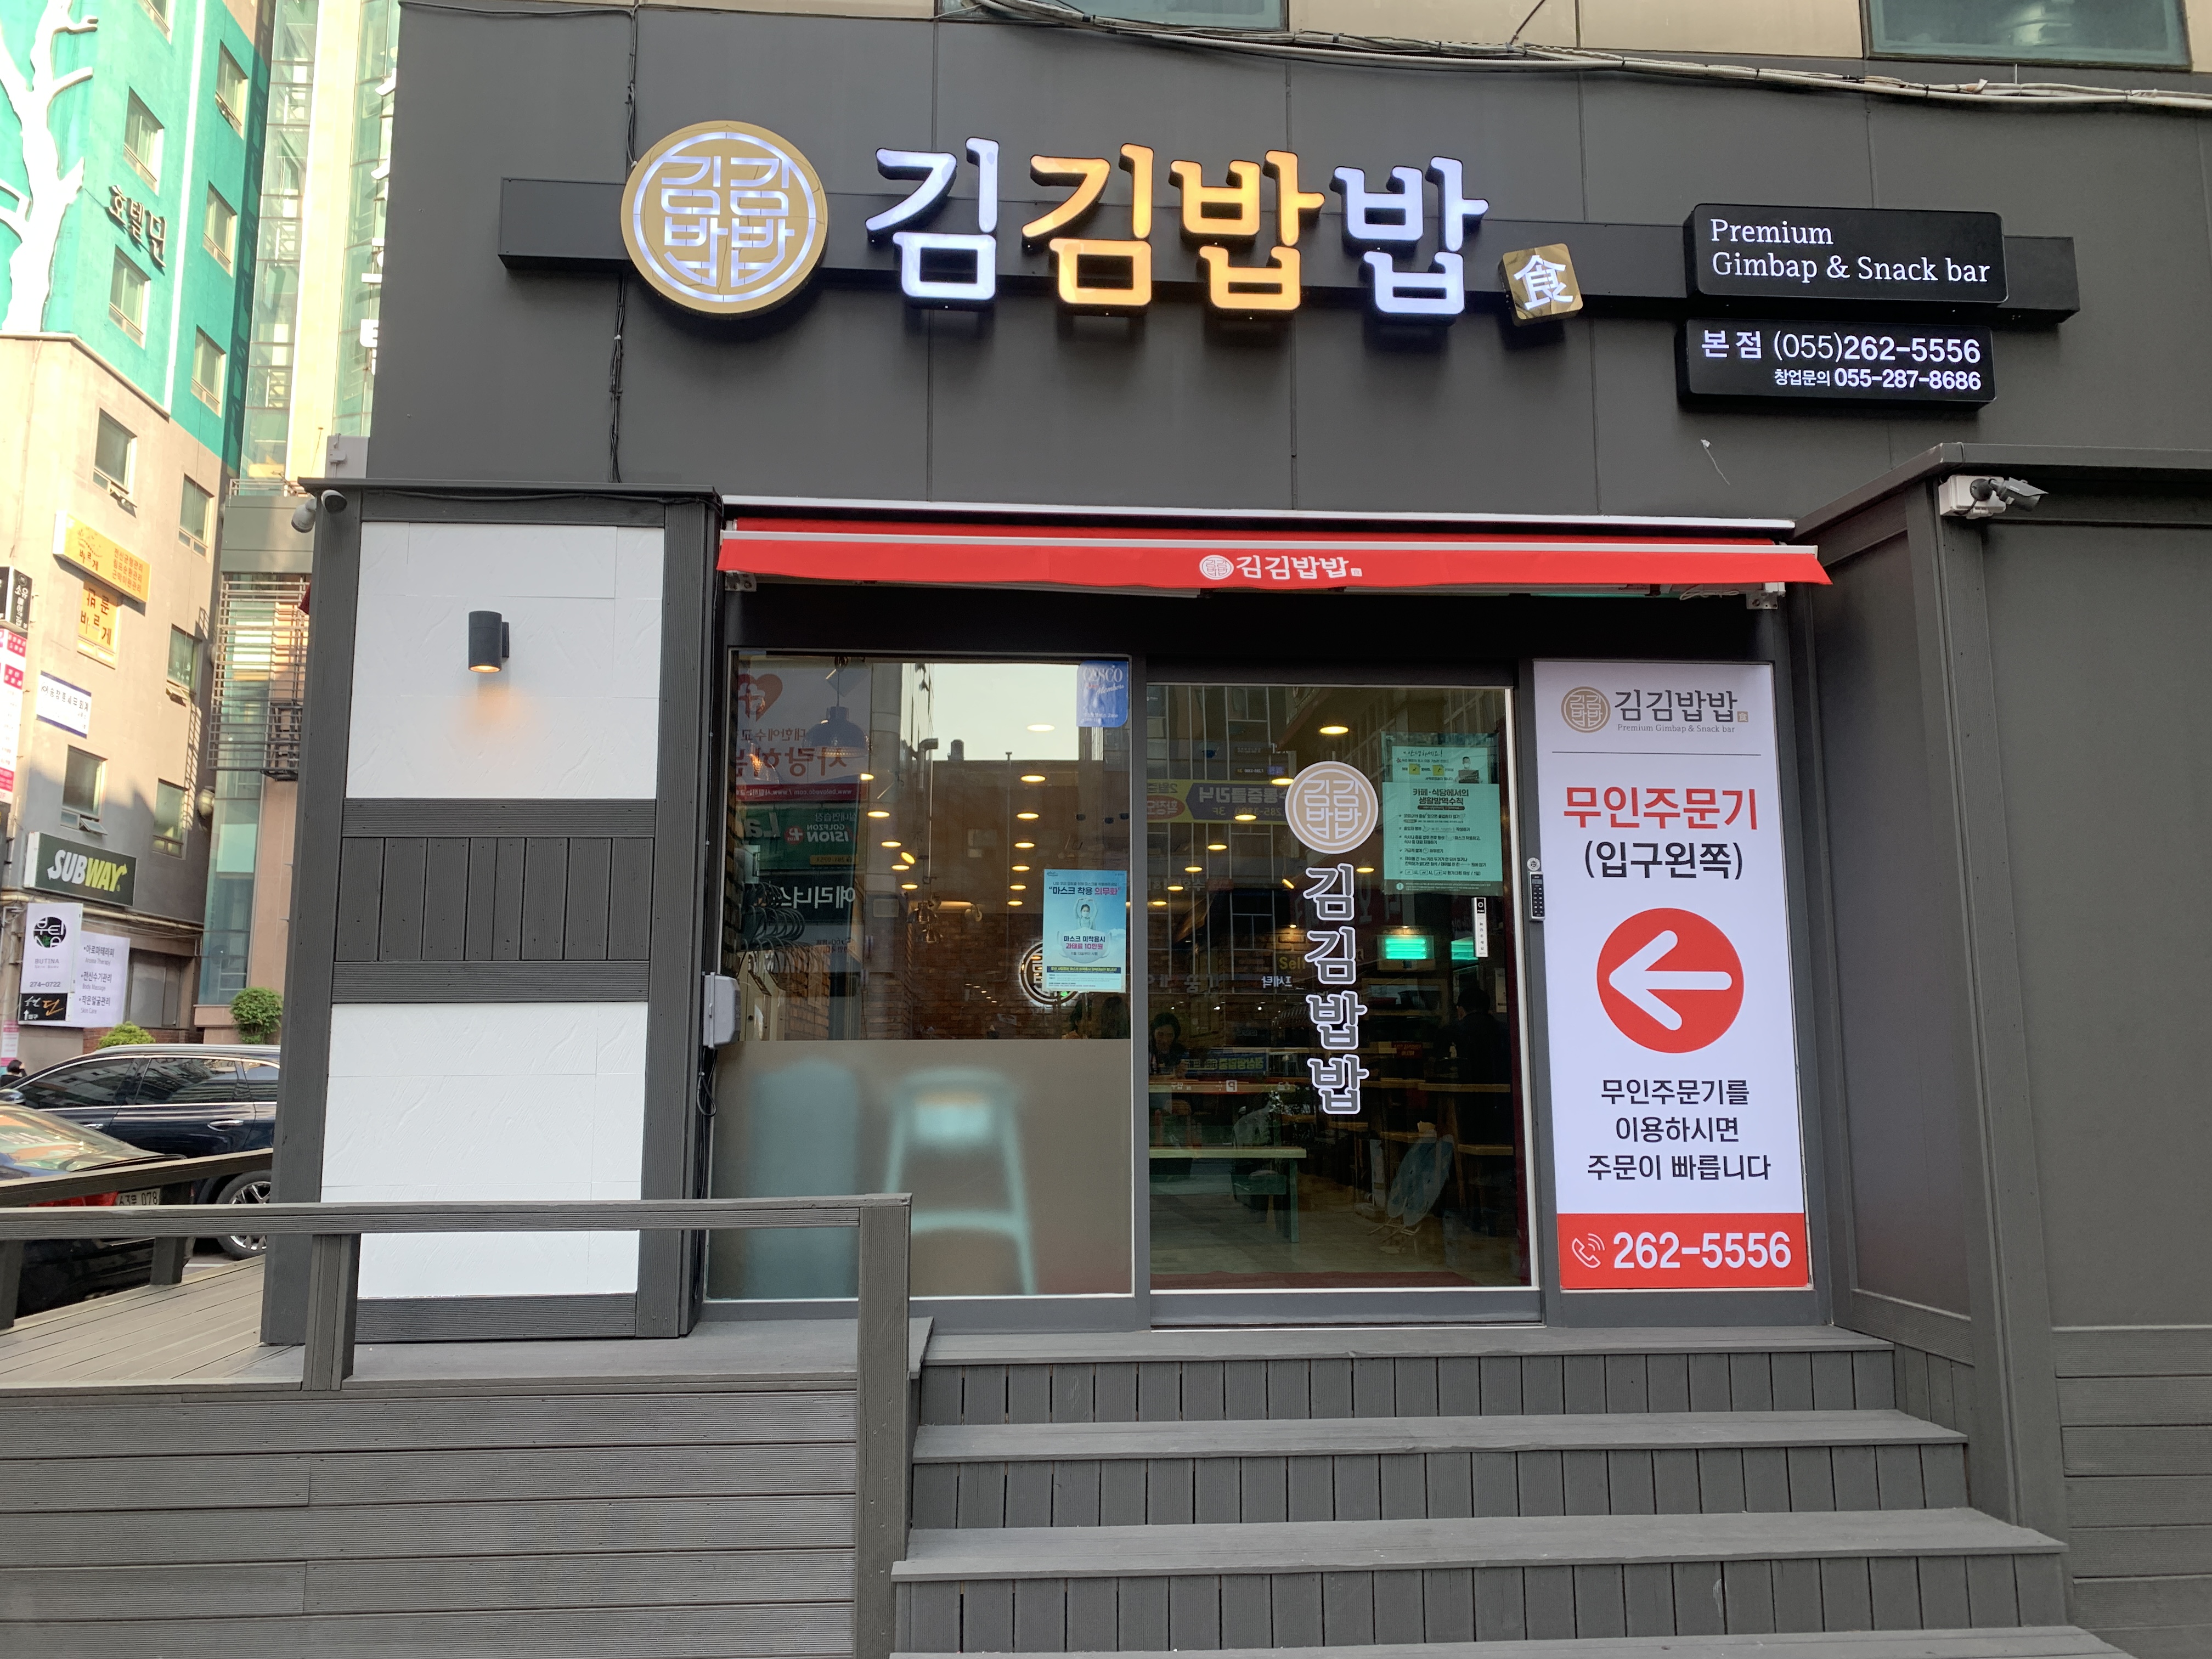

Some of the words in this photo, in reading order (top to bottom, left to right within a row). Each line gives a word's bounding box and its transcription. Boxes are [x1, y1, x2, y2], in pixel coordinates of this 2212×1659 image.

[865, 137, 1489, 314] 김김밥밥
[1710, 218, 1833, 245] Premium
[1712, 251, 1818, 284] Gimbap
[1826, 255, 1850, 279] &
[1858, 256, 1939, 281] Snack
[1945, 257, 1990, 282] bar
[1514, 255, 1573, 309] 食
[1774, 330, 1981, 363] (055)262-5556
[1774, 369, 1831, 386] 창업문의
[1834, 368, 1982, 391] 055-287-8686
[80, 549, 98, 571] 바르게
[1236, 555, 1349, 580] 김김밥밥
[81, 610, 111, 645] 바르게
[1615, 689, 1738, 723] 김김밥밥
[1656, 724, 1686, 733] Gimbap
[1697, 725, 1720, 733] Snack
[1419, 797, 1463, 805] 생활방역수칙
[1564, 786, 1757, 830] 무인주문기
[47, 849, 127, 892] SUBWAY
[1585, 840, 1742, 880] (입구왼쪽)
[1077, 887, 1092, 895] 착용
[86, 945, 114, 957] 아로마테라피
[83, 971, 112, 983] 전신수기관리
[1302, 863, 1369, 1115] 김김밥밥
[1601, 1079, 1750, 1105] 무인주문기를
[1616, 1116, 1739, 1143] 이용하시면
[1587, 1155, 1661, 1181] 주문이
[1672, 1155, 1771, 1181] 빠릅니다
[1613, 1231, 1792, 1269] 262-5556
